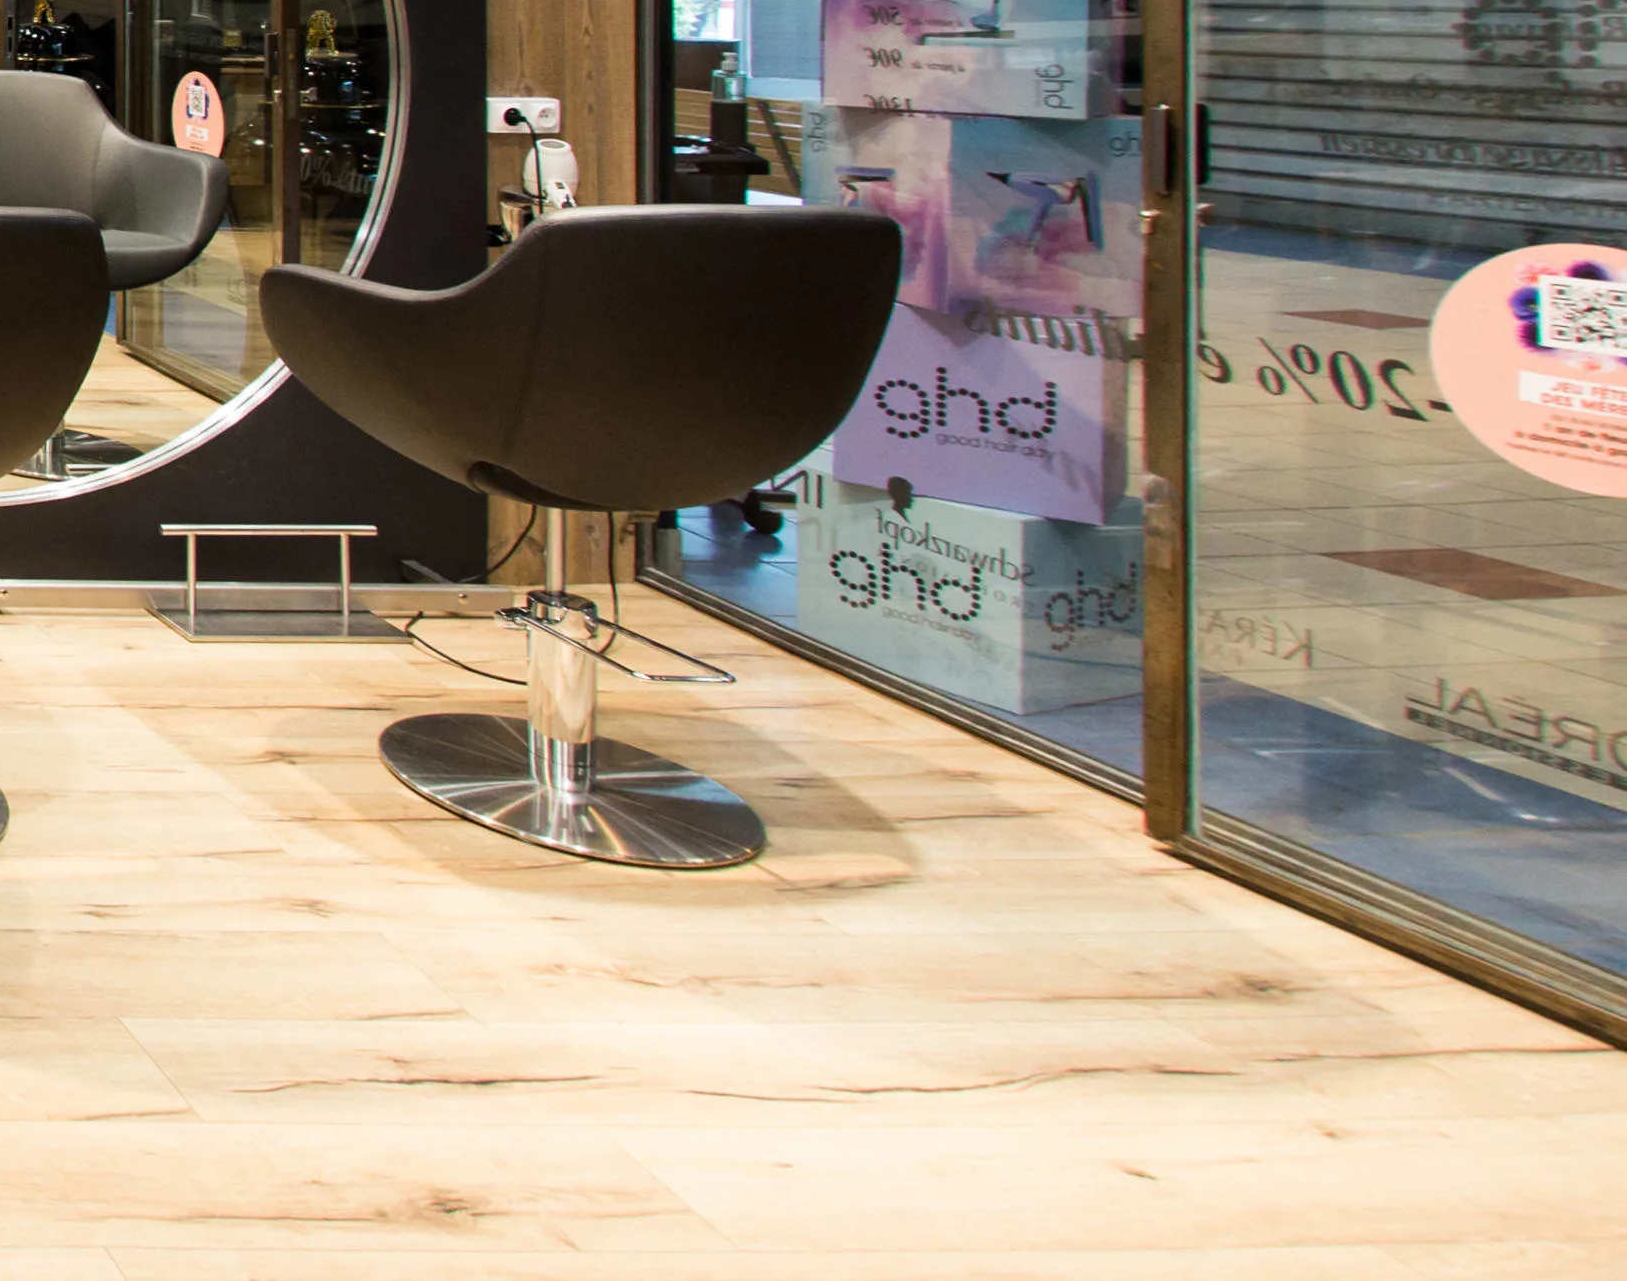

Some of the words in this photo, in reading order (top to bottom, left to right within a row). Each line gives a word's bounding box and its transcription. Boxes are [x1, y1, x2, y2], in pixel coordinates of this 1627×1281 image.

[1108, 130, 1142, 159] gh
[874, 366, 1058, 439] ghd
[936, 431, 982, 449] good
[983, 437, 1020, 454] hair
[829, 541, 982, 621] ghd
